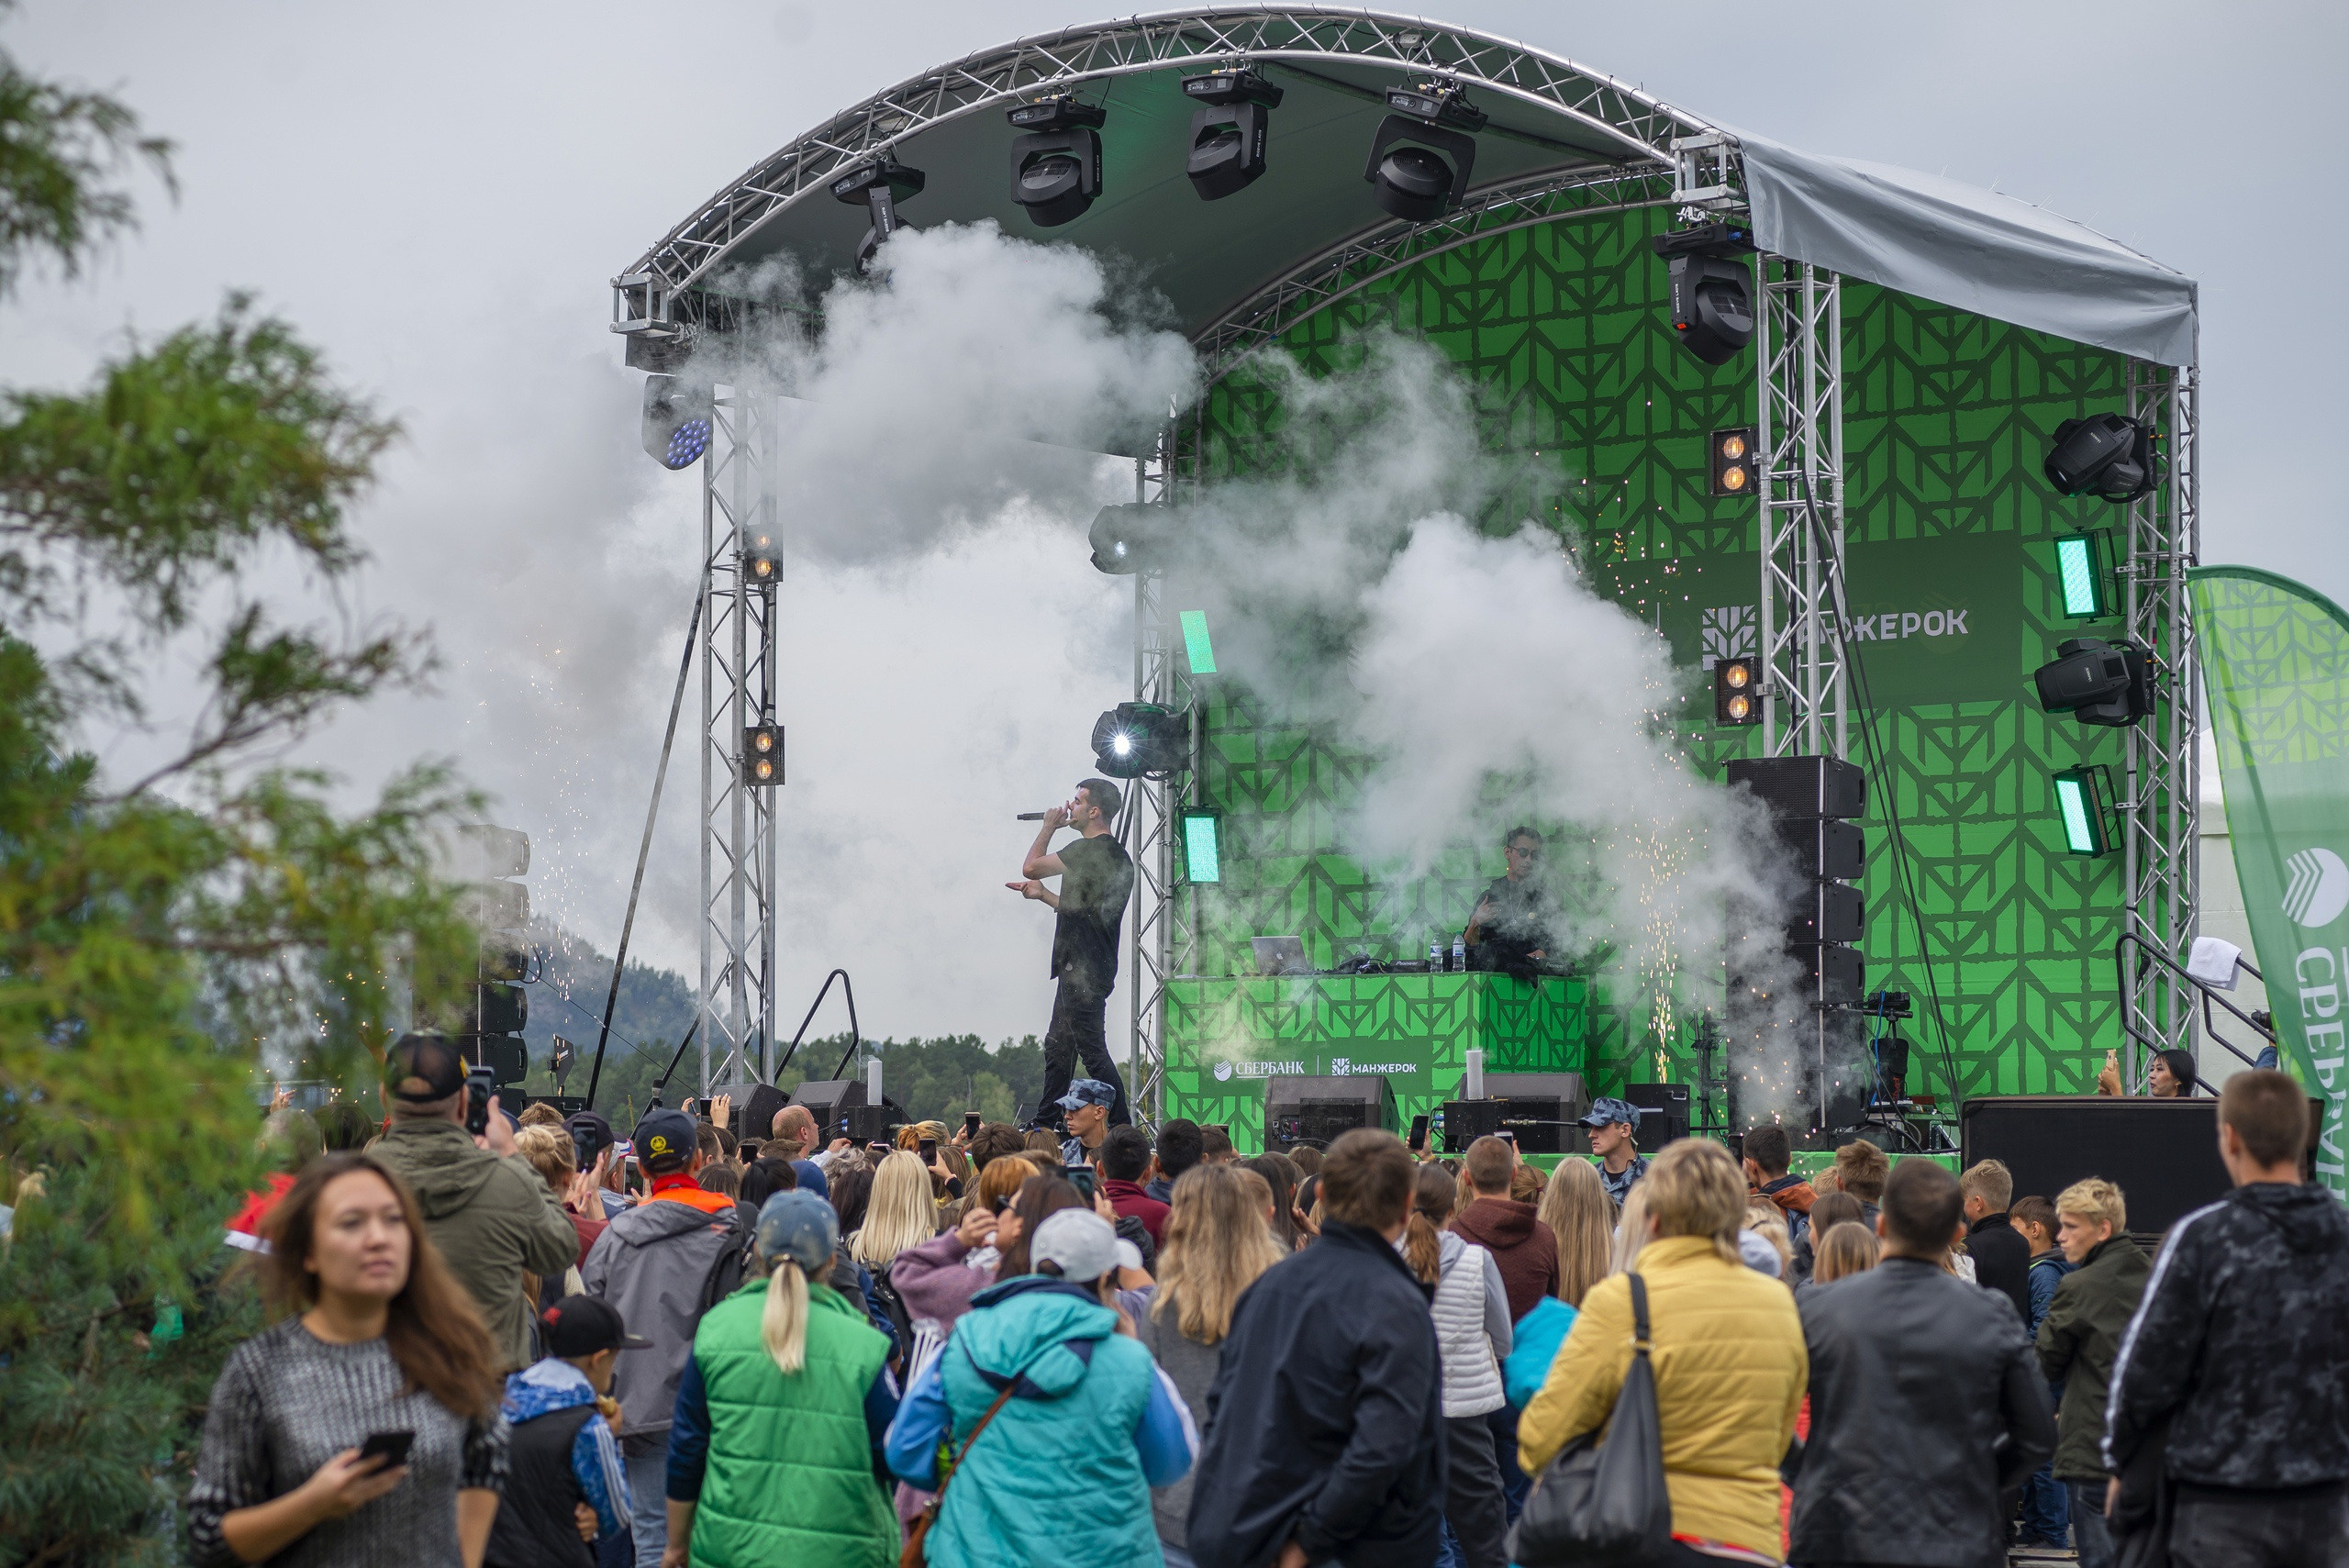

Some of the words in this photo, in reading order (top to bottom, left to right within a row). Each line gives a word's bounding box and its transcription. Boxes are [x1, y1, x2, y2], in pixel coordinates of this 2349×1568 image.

[1771, 608, 1969, 647] НЖЕРОК
[1236, 1061, 1305, 1074] СБЕРБАНК
[1352, 1063, 1417, 1073] МАНЖЕРОК
